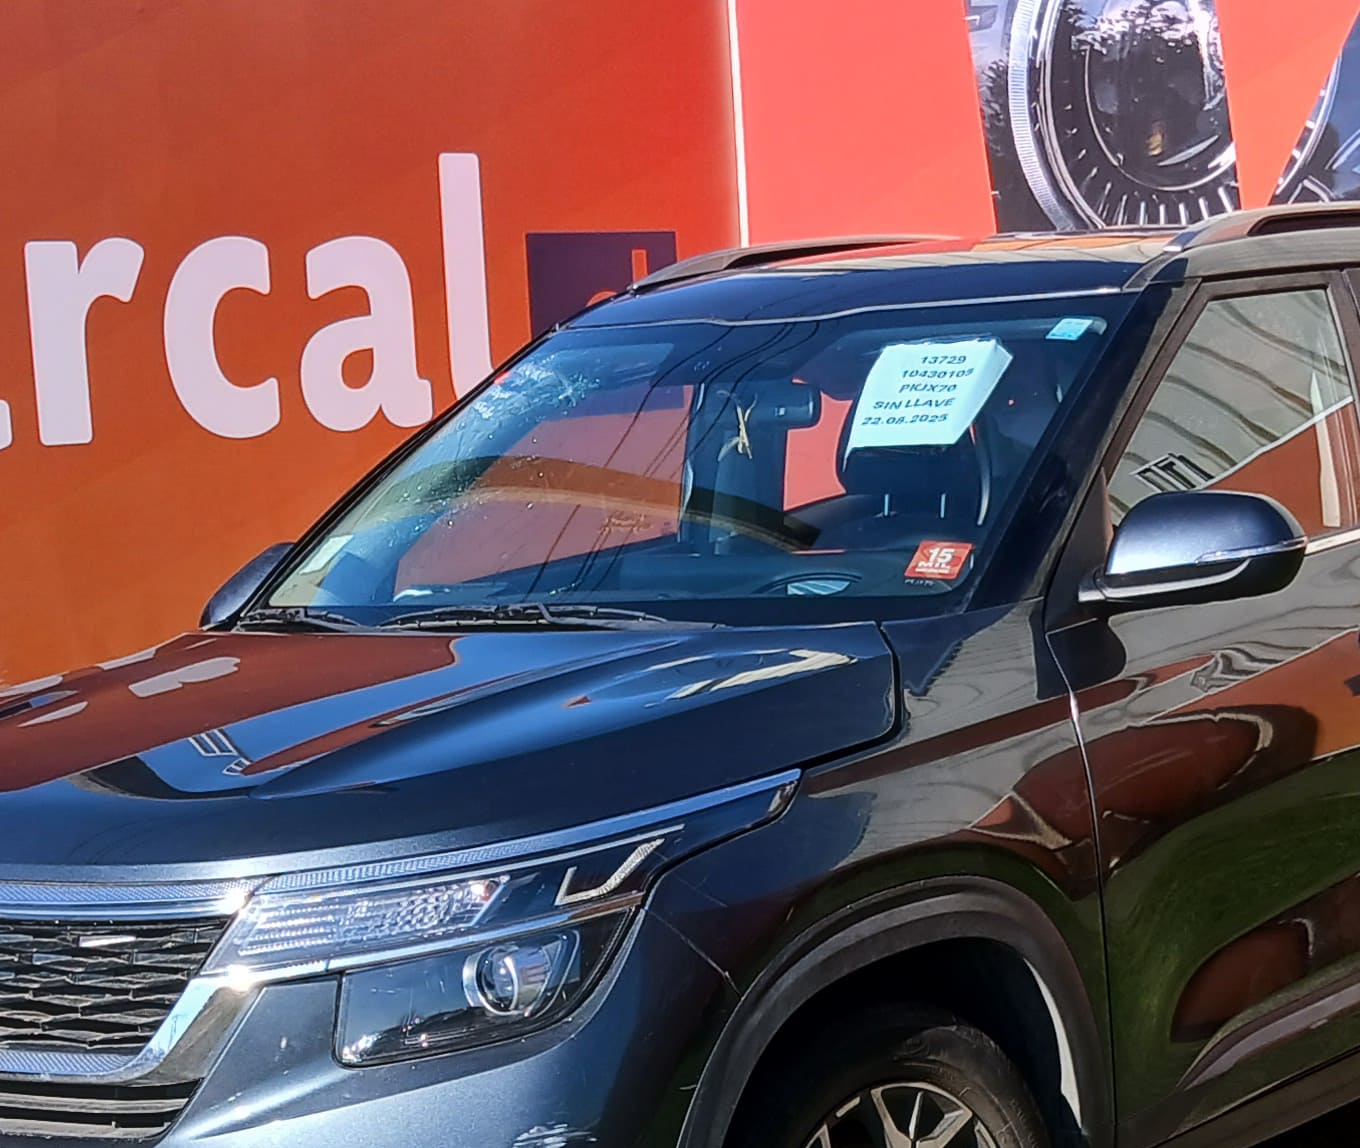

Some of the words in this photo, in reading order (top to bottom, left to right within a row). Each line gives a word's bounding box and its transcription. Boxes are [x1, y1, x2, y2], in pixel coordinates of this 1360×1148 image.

[921, 355, 967, 365] 13729
[872, 400, 903, 410] SIN
[904, 397, 957, 408] LLAVE
[929, 548, 955, 563] 15
